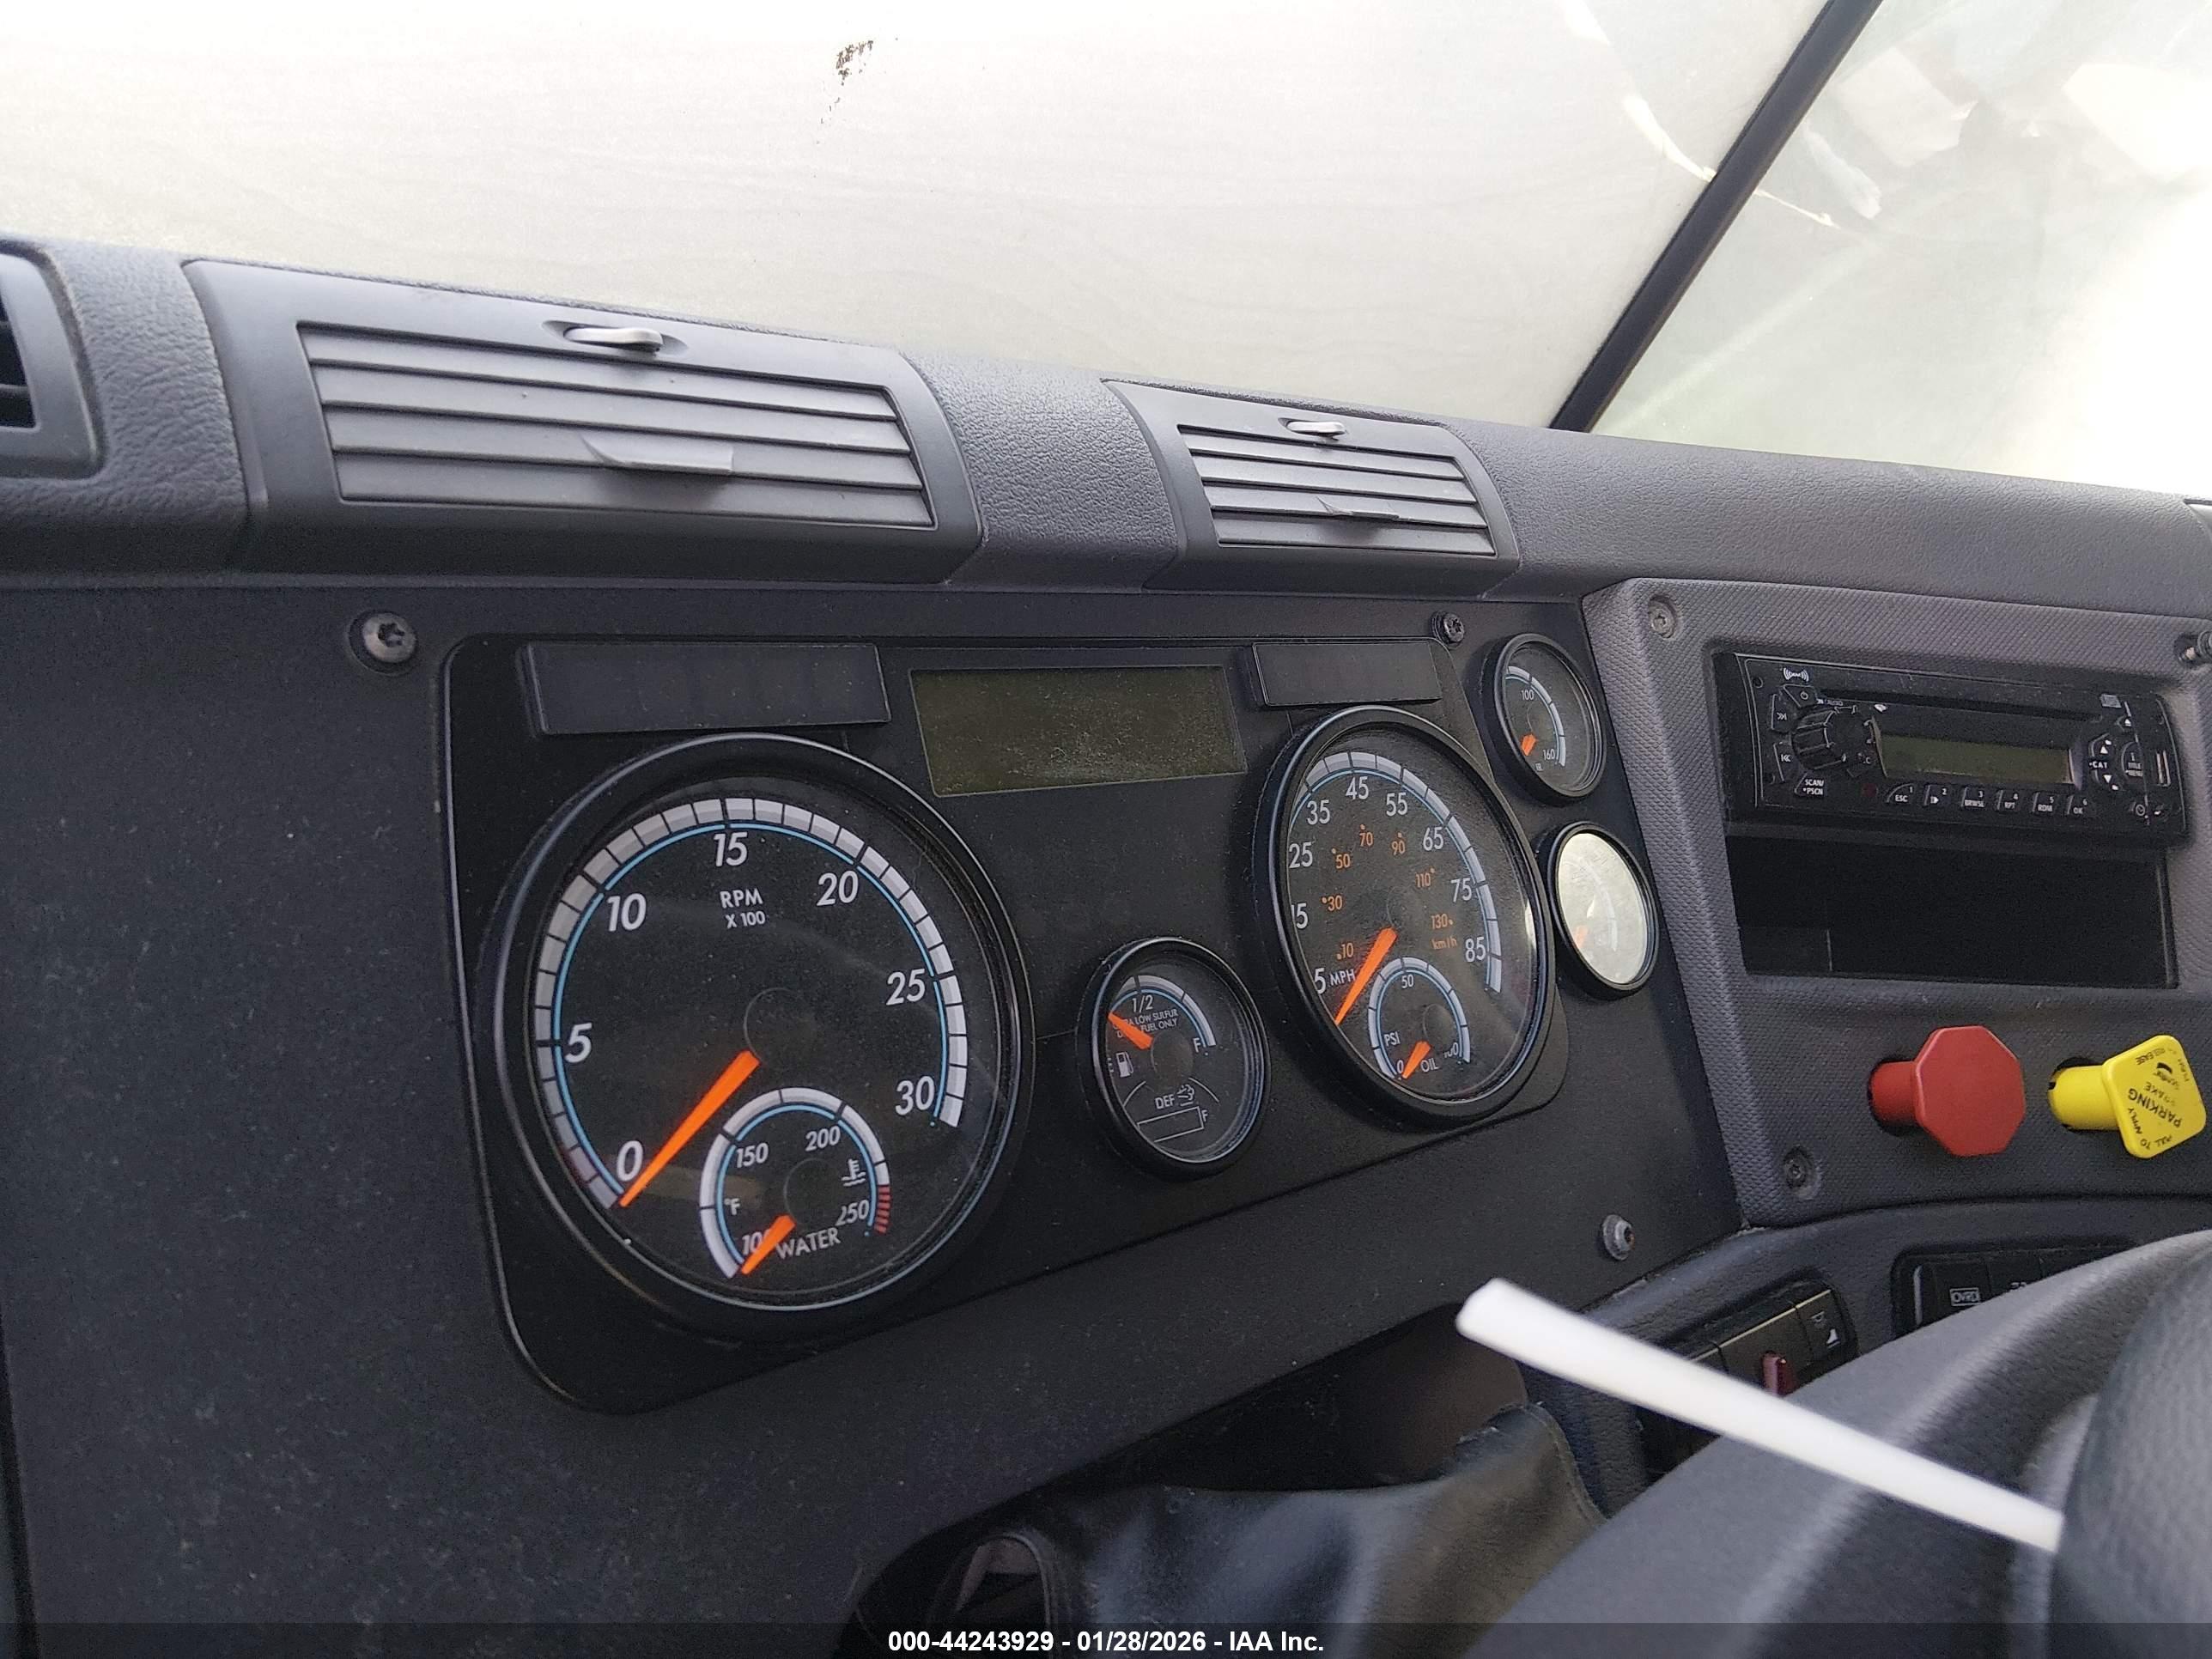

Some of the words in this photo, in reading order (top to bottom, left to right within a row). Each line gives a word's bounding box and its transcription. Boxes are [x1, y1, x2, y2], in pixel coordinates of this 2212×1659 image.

[1521, 690, 1534, 701] 100
[1542, 748, 1556, 761] 160
[1346, 775, 1370, 801] 45
[1385, 792, 1408, 817] 55
[1894, 794, 1909, 803] ESC
[1306, 799, 1331, 826] 35
[2073, 806, 2083, 815] OK
[1358, 830, 1373, 848] 70
[1391, 839, 1406, 856] 90
[1422, 825, 1444, 851] 65
[713, 831, 749, 867] 15
[1288, 842, 1313, 869] 25
[1334, 853, 1351, 870] 50
[817, 872, 859, 907] 20
[1415, 872, 1432, 889] 110
[1449, 877, 1473, 903] 75
[720, 888, 763, 909] RPM
[1328, 895, 1343, 911] 30
[606, 892, 647, 932] 10
[726, 915, 738, 929] X
[740, 910, 767, 927] 100
[1431, 913, 1448, 929] 130
[1341, 942, 1354, 958] 10
[1431, 936, 1457, 950] km/h
[1465, 936, 1486, 963] 85
[1314, 967, 1327, 994] 5
[1328, 968, 1356, 987] MPH
[1401, 974, 1414, 989] 50
[886, 969, 927, 1006] 25
[1132, 994, 1154, 1013] 1/2
[1134, 1014, 1152, 1024] LOW
[1152, 1008, 1179, 1021] SULFUR
[1140, 1023, 1159, 1032] FUEL
[1158, 1018, 1178, 1030] ONLY
[565, 1023, 592, 1063] 5
[1192, 1037, 1201, 1053] F
[1383, 1031, 1401, 1047] PSI
[1396, 1059, 1404, 1073] 0
[1420, 1057, 1439, 1073] OIL
[895, 1075, 936, 1116] 30
[1154, 1093, 1176, 1109] DEF
[1201, 1109, 1209, 1122] F
[2127, 1087, 2183, 1128] PARKING
[805, 1125, 842, 1152] 200
[2140, 1138, 2151, 1151] TO
[617, 1139, 644, 1182] 0
[735, 1142, 769, 1168] 150
[835, 1199, 870, 1227] 250
[775, 1227, 842, 1260] WATER
